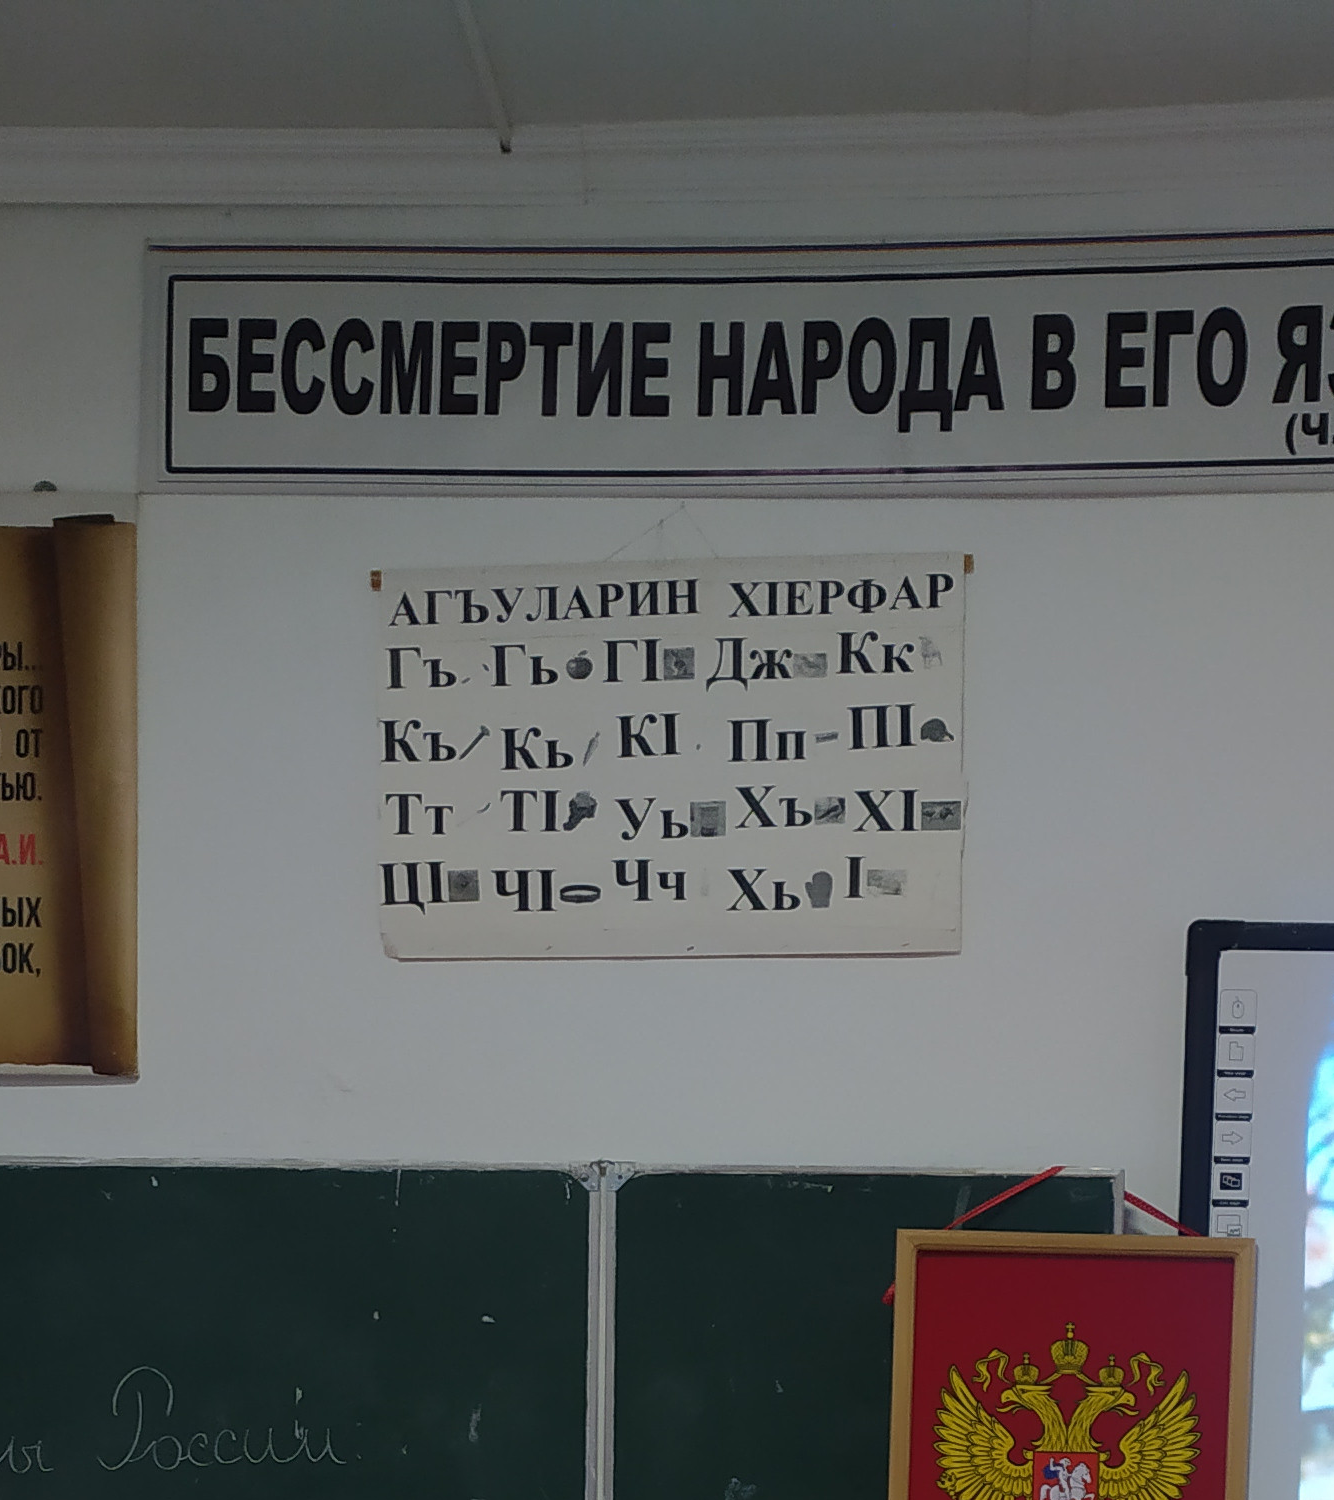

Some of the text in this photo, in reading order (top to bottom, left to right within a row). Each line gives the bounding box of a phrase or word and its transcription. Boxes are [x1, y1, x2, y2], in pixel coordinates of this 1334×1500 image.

[189, 318, 671, 417] БЕССМЕРТИЕ
[698, 317, 1004, 433] НАРОДА
[1031, 314, 1076, 410] В
[1105, 307, 1248, 408] ЕГО
[390, 579, 697, 626] АГЪУЛАРИН
[388, 647, 456, 688] Гъ
[491, 645, 558, 686] Гь
[706, 638, 792, 690] Дж
[837, 632, 914, 673] Кк
[16, 729, 43, 758] ОТ
[381, 720, 456, 762] Къ
[502, 728, 573, 770] Кь
[731, 719, 805, 761] Пп
[386, 794, 453, 835] Тт
[616, 798, 688, 840] Уь
[736, 786, 812, 828] Хъ
[614, 860, 685, 901] Чч
[728, 869, 800, 910] Хь
